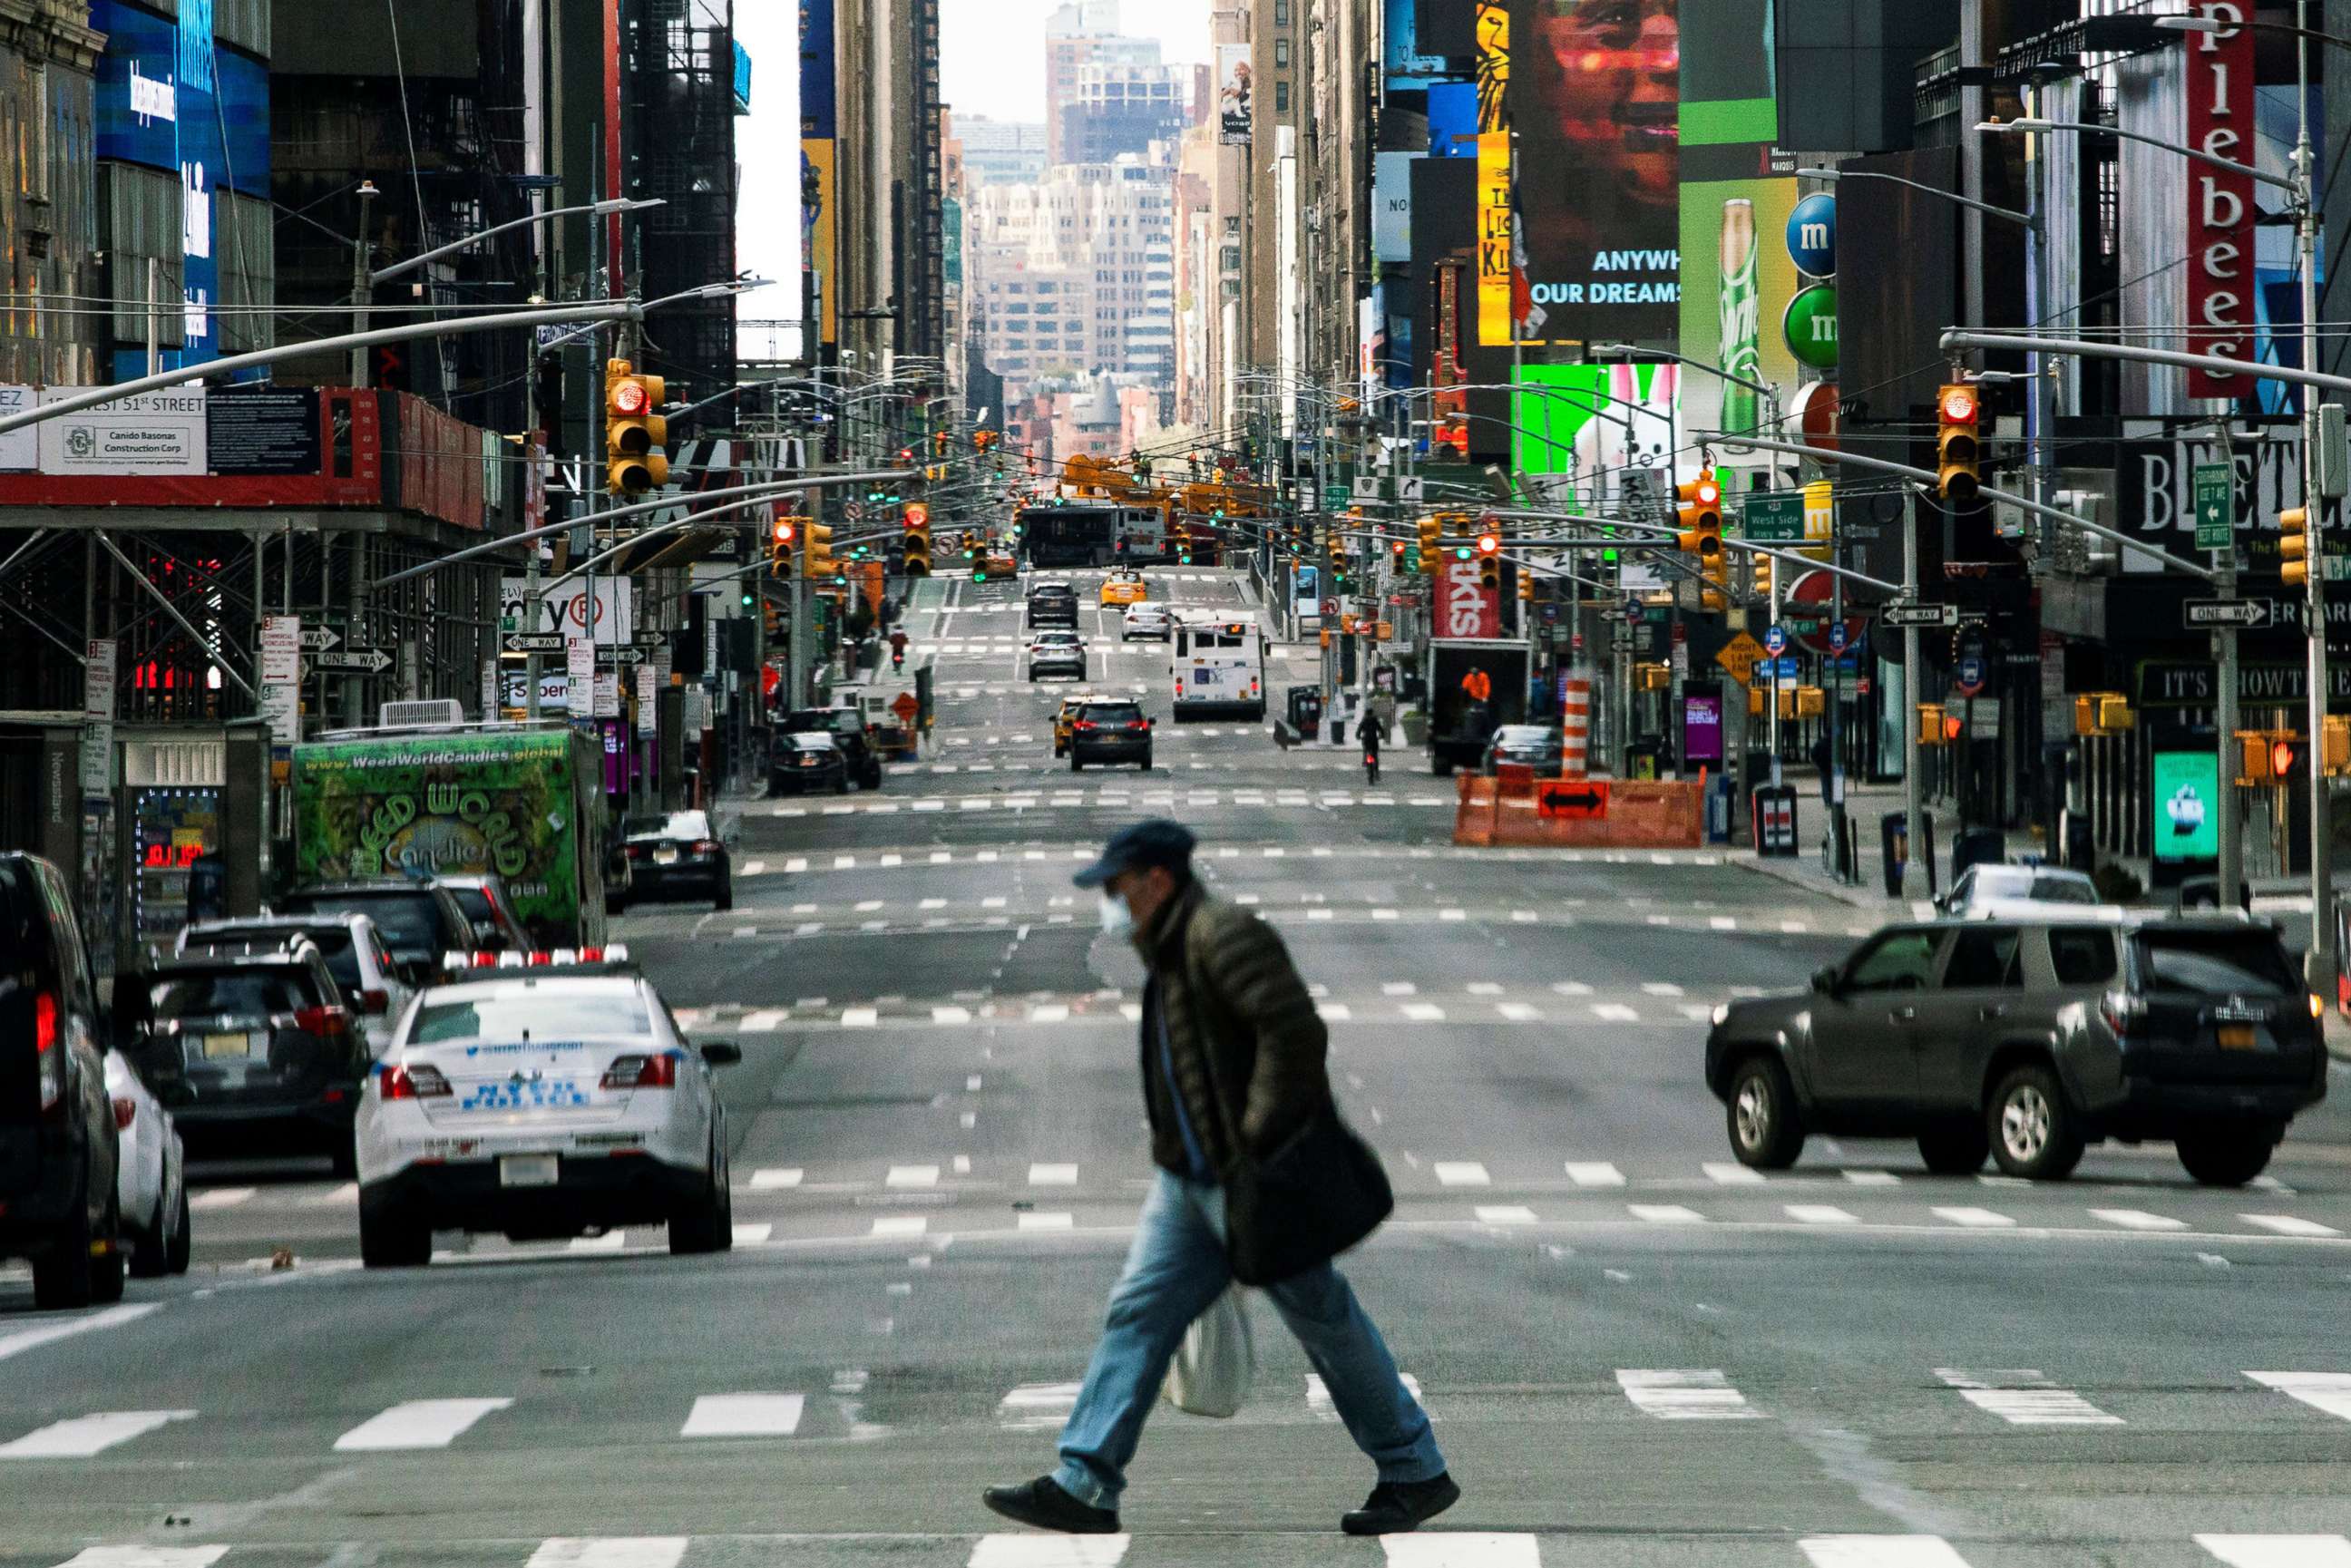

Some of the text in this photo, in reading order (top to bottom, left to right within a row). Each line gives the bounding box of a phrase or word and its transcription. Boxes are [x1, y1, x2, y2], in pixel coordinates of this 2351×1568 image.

[1800, 223, 1829, 249] m
[1530, 283, 1585, 303] OUR
[153, 397, 204, 412] STREET
[110, 432, 176, 440] Canido Basonas
[104, 444, 181, 453] Construction Corp
[1751, 514, 1799, 524] West Side
[1753, 531, 1773, 540] Hwy
[1917, 610, 1935, 618] WAY
[2198, 608, 2258, 619] ONE WAY
[305, 632, 332, 645] WAY
[511, 638, 557, 648] ONE WAY
[324, 653, 384, 667] ONE WAY
